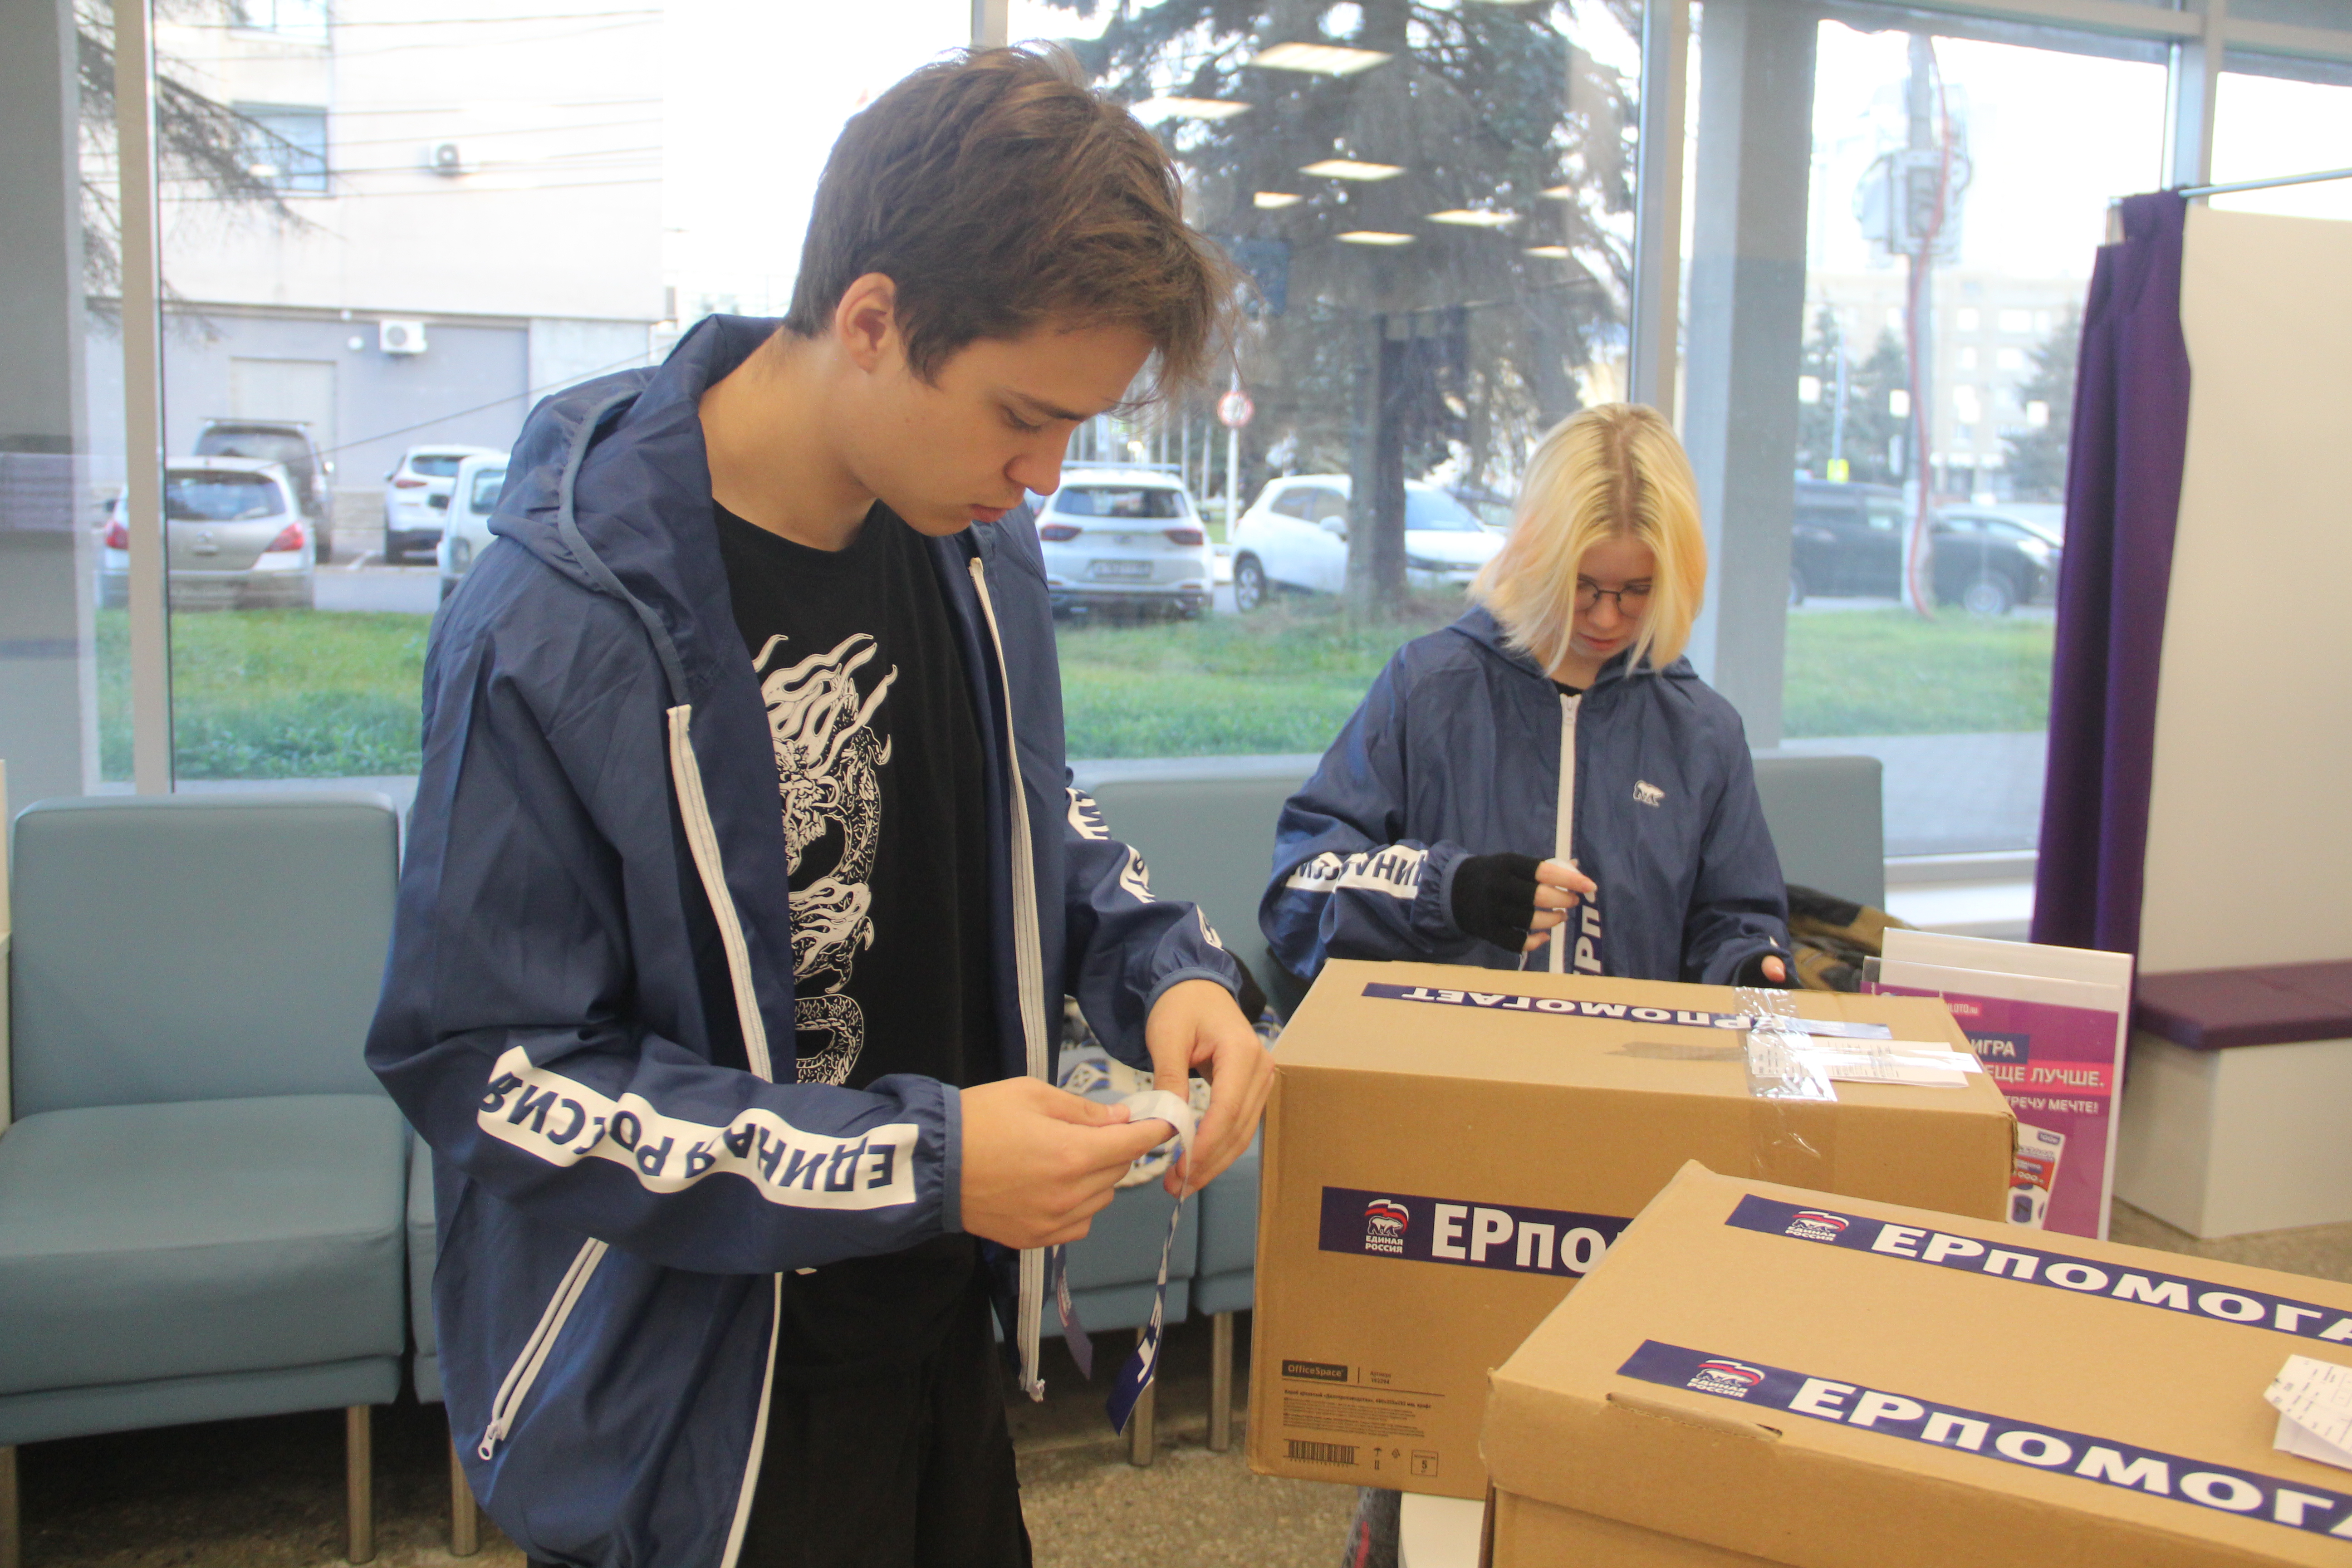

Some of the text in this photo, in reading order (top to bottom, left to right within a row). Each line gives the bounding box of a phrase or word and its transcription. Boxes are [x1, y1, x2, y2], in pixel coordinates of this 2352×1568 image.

[1970, 1039, 2016, 1058] ИГРА
[2030, 1067, 2105, 1088] ЛУЧШЕ.
[2048, 1098, 2098, 1114] МЕЧТЕ!
[480, 1071, 897, 1192] ЕДИНАЯ РОССИЯ
[1431, 1203, 1621, 1274] ЕРПО
[1784, 1229, 1834, 1242] РОССИЯ
[1788, 1225, 1837, 1238] ЕДИНАЯ
[1365, 1235, 1403, 1246] ЕДИНАЯ
[1365, 1242, 1403, 1254] РОССИЯ
[1288, 1364, 1342, 1377] OfficeSpace
[1686, 1382, 1745, 1398] РОССИЯ
[1690, 1377, 1749, 1393] ЕДИНАЯ
